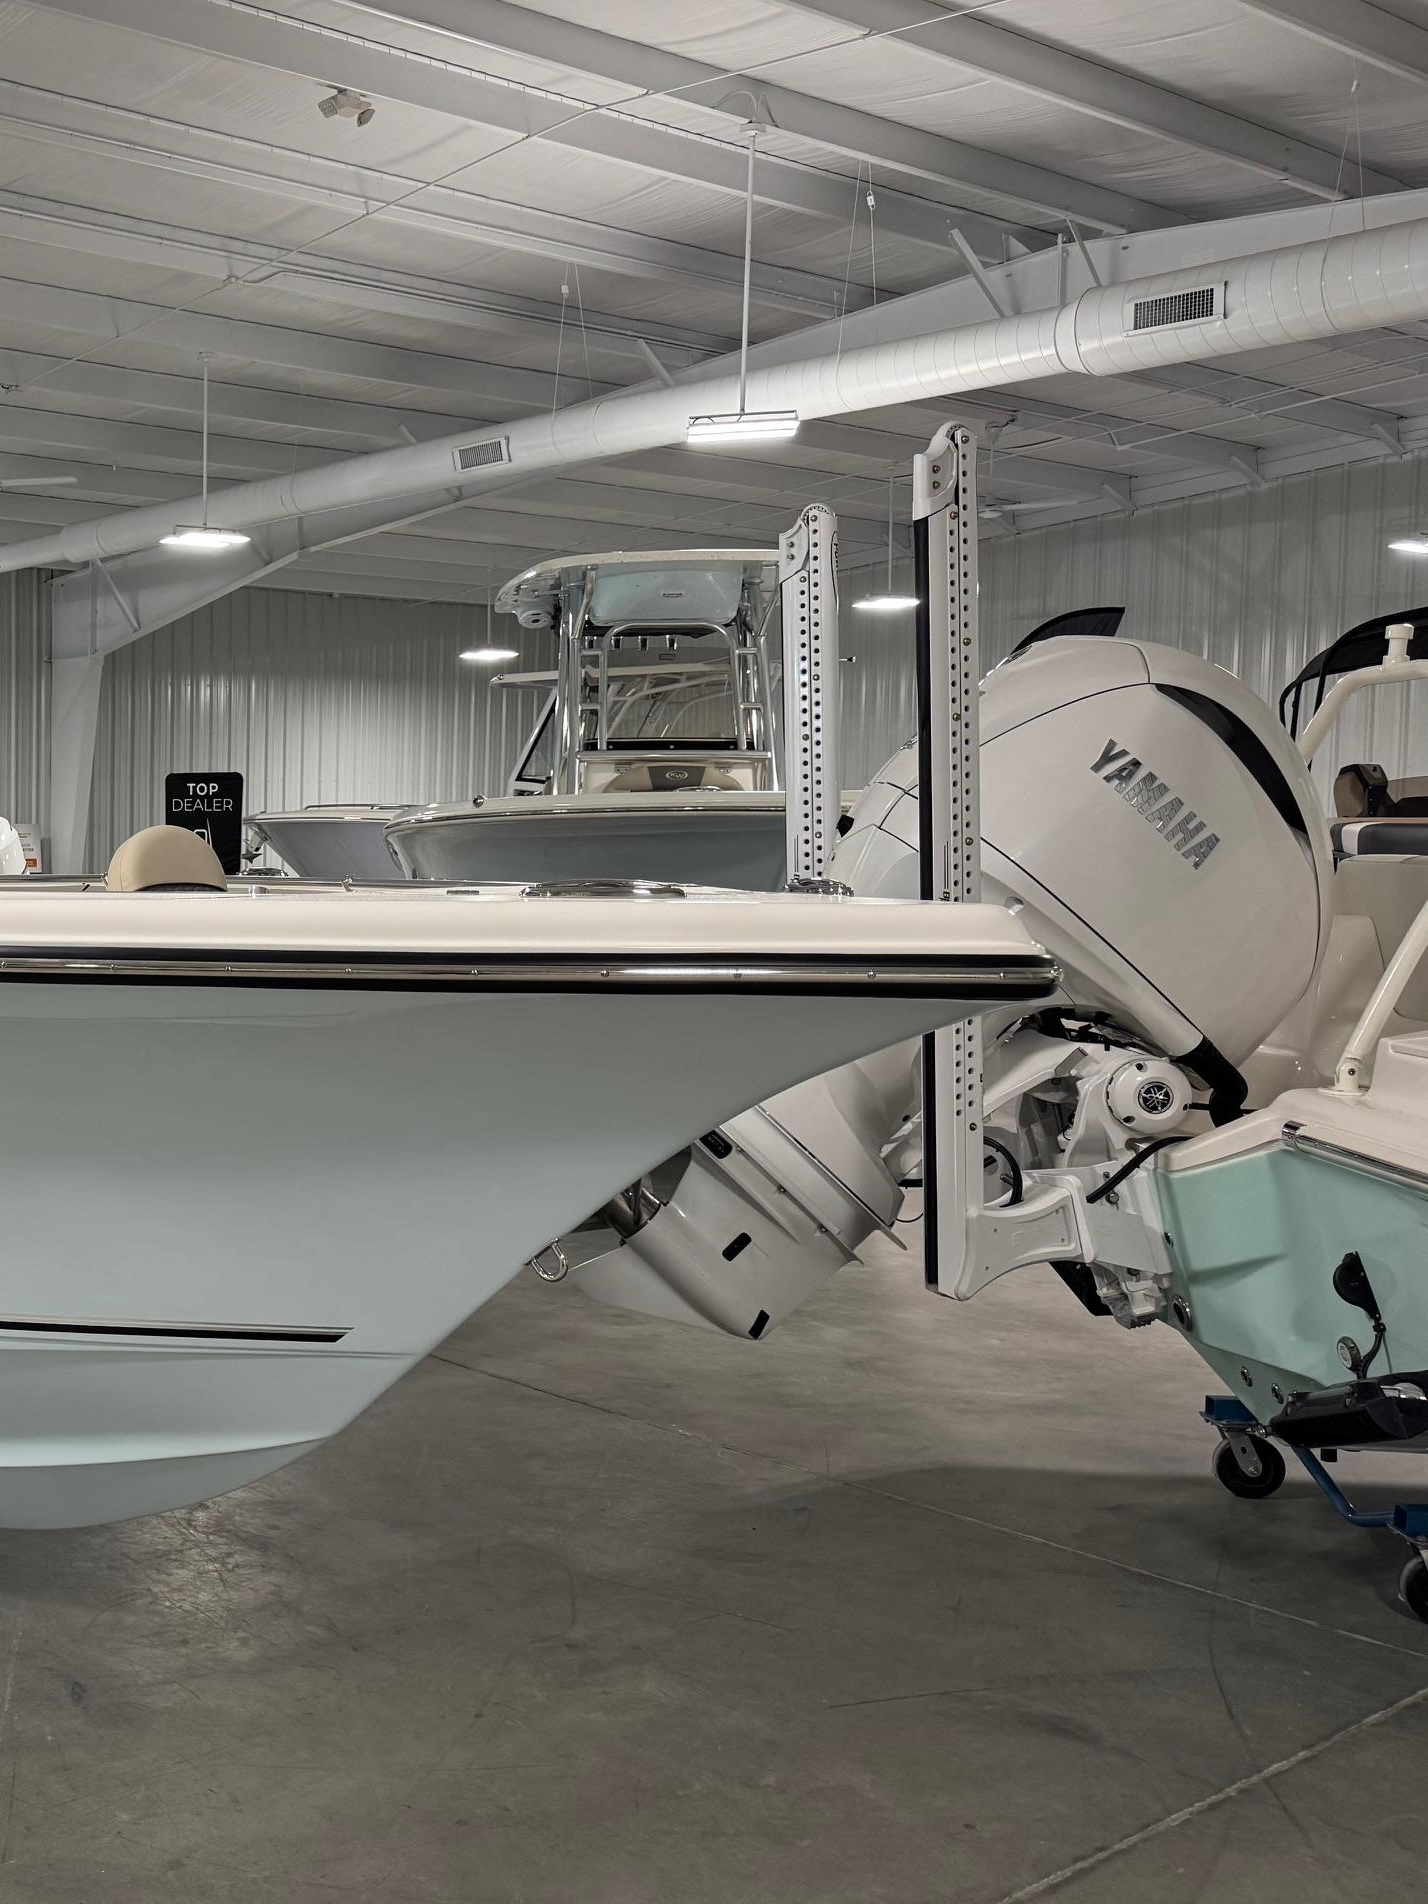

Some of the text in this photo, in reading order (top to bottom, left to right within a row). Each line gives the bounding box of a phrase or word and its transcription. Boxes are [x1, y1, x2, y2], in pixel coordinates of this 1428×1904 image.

[186, 783, 219, 796] TOP
[172, 798, 233, 812] DEALER
[1089, 738, 1220, 870] YAMAHA
